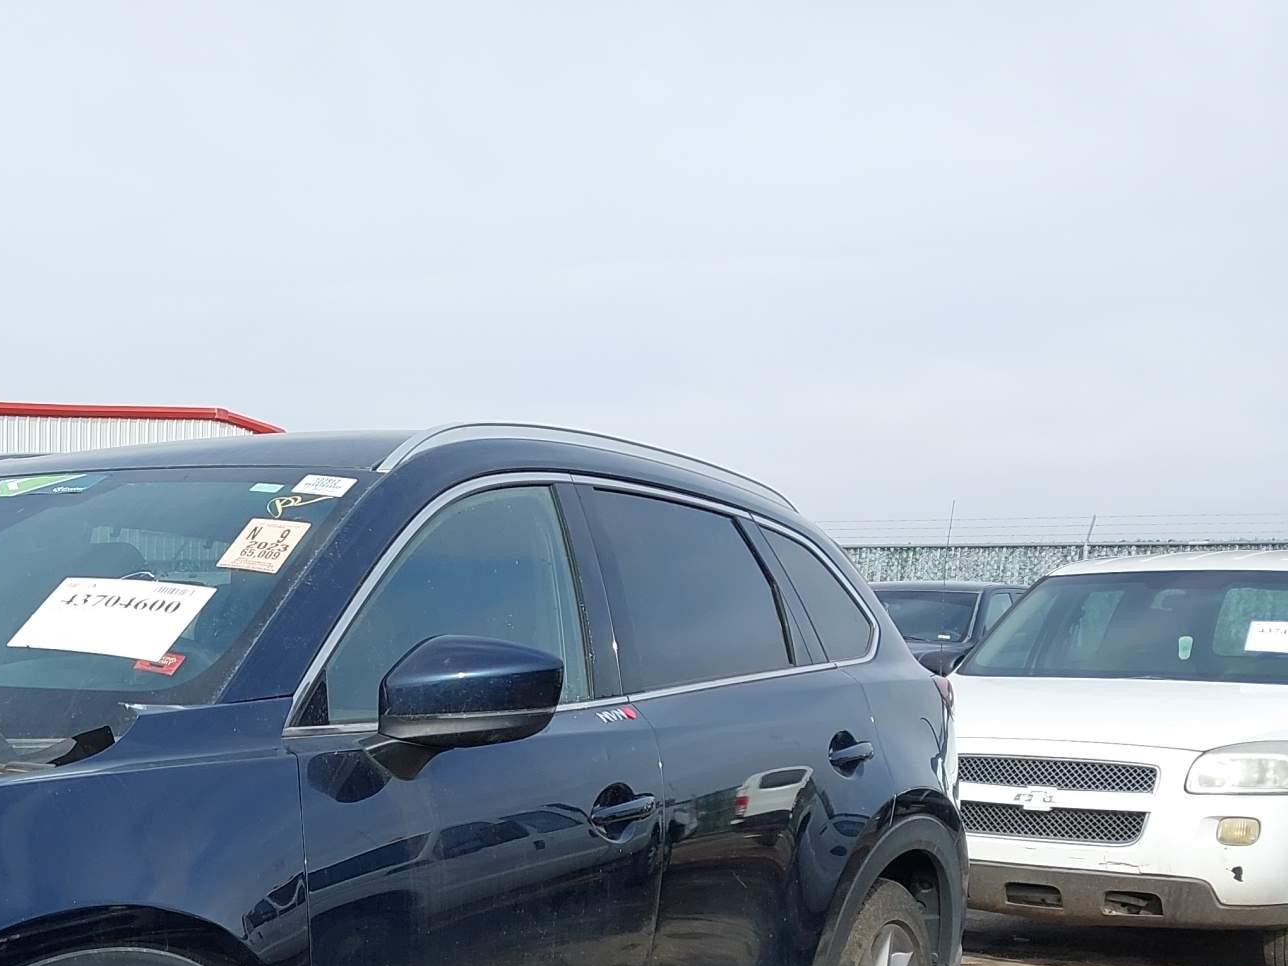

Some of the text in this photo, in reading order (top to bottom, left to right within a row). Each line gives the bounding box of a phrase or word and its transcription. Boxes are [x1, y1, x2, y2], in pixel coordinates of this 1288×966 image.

[245, 525, 263, 541] N
[276, 528, 291, 544] 9
[239, 548, 281, 561] 65,009
[245, 540, 290, 553] 2023
[61, 593, 182, 614] 43704600
